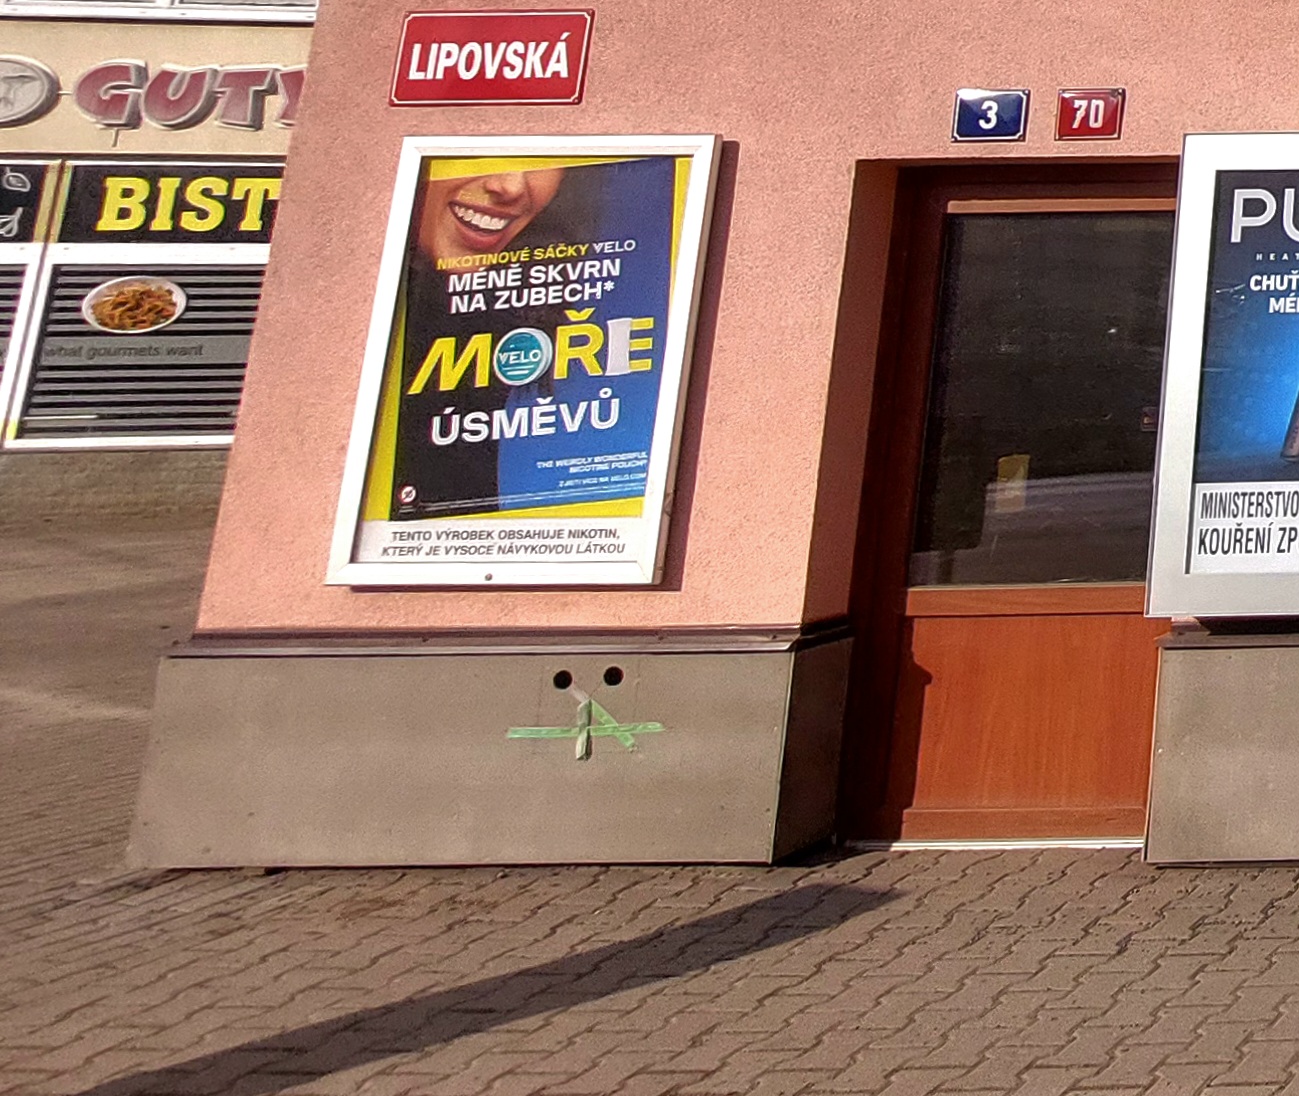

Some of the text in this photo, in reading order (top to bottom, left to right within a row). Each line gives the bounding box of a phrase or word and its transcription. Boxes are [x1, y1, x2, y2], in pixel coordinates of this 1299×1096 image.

[407, 31, 572, 81] LIPOVSKÁ
[978, 99, 999, 130] 3
[1071, 98, 1106, 129] 70
[436, 239, 637, 271] NIKOTINOVÉ SÁČKY VELO
[448, 258, 621, 293] MÉNĚ SKVRN
[450, 292, 487, 315] NA
[499, 349, 542, 365] VELO
[431, 387, 621, 446] ÚSMĚVŮ
[1200, 490, 1299, 519] MINISTERSTVO
[381, 540, 627, 557] KTERÝ JE VYSOCE NÁVYKOVOU LÁTKOU
[391, 527, 621, 542] TENTO VÝROBEK OBSAHUJE NIKOTIN,
[1198, 521, 1274, 555] KOUŘENÍ
